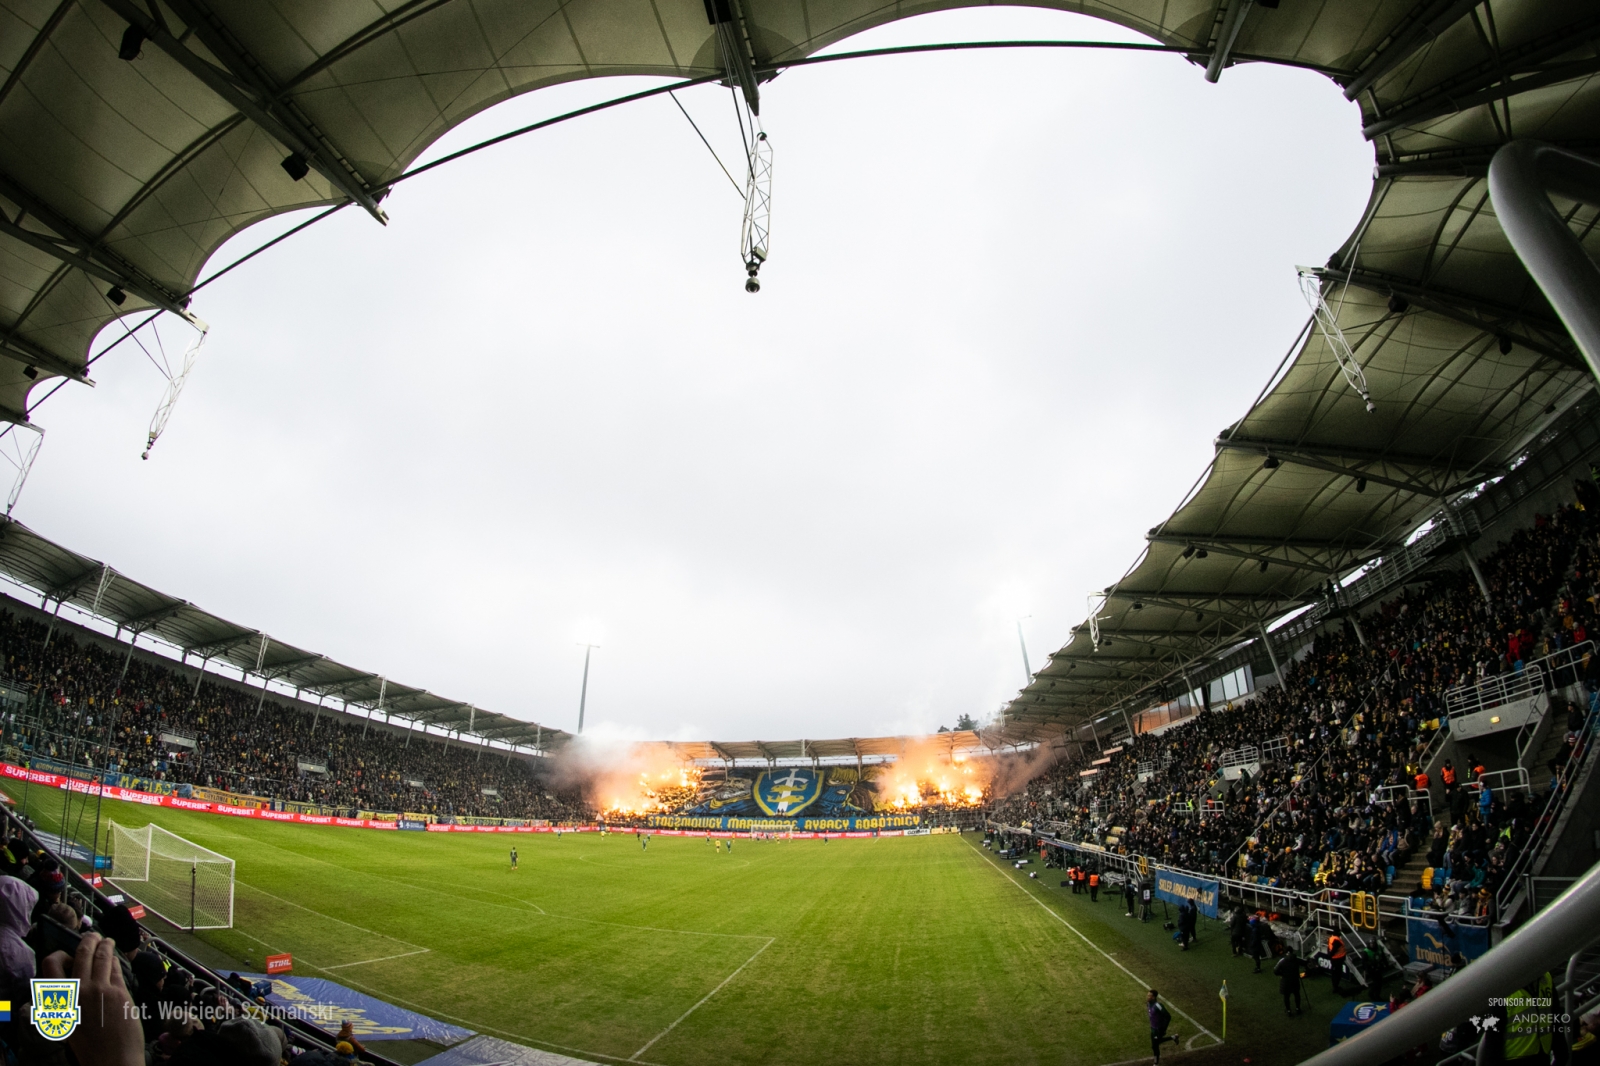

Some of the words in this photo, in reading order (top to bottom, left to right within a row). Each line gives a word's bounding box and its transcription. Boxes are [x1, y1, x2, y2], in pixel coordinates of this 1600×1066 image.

[4, 765, 57, 783] SUPERBET
[65, 779, 113, 796] SUPERBET
[119, 789, 164, 804] SUPERBET
[171, 798, 211, 811] SUPERBET
[217, 804, 256, 816] SUPERBET
[261, 810, 295, 820] SUPERBET
[300, 814, 331, 824] SUPERBET
[268, 959, 291, 968] STIHL
